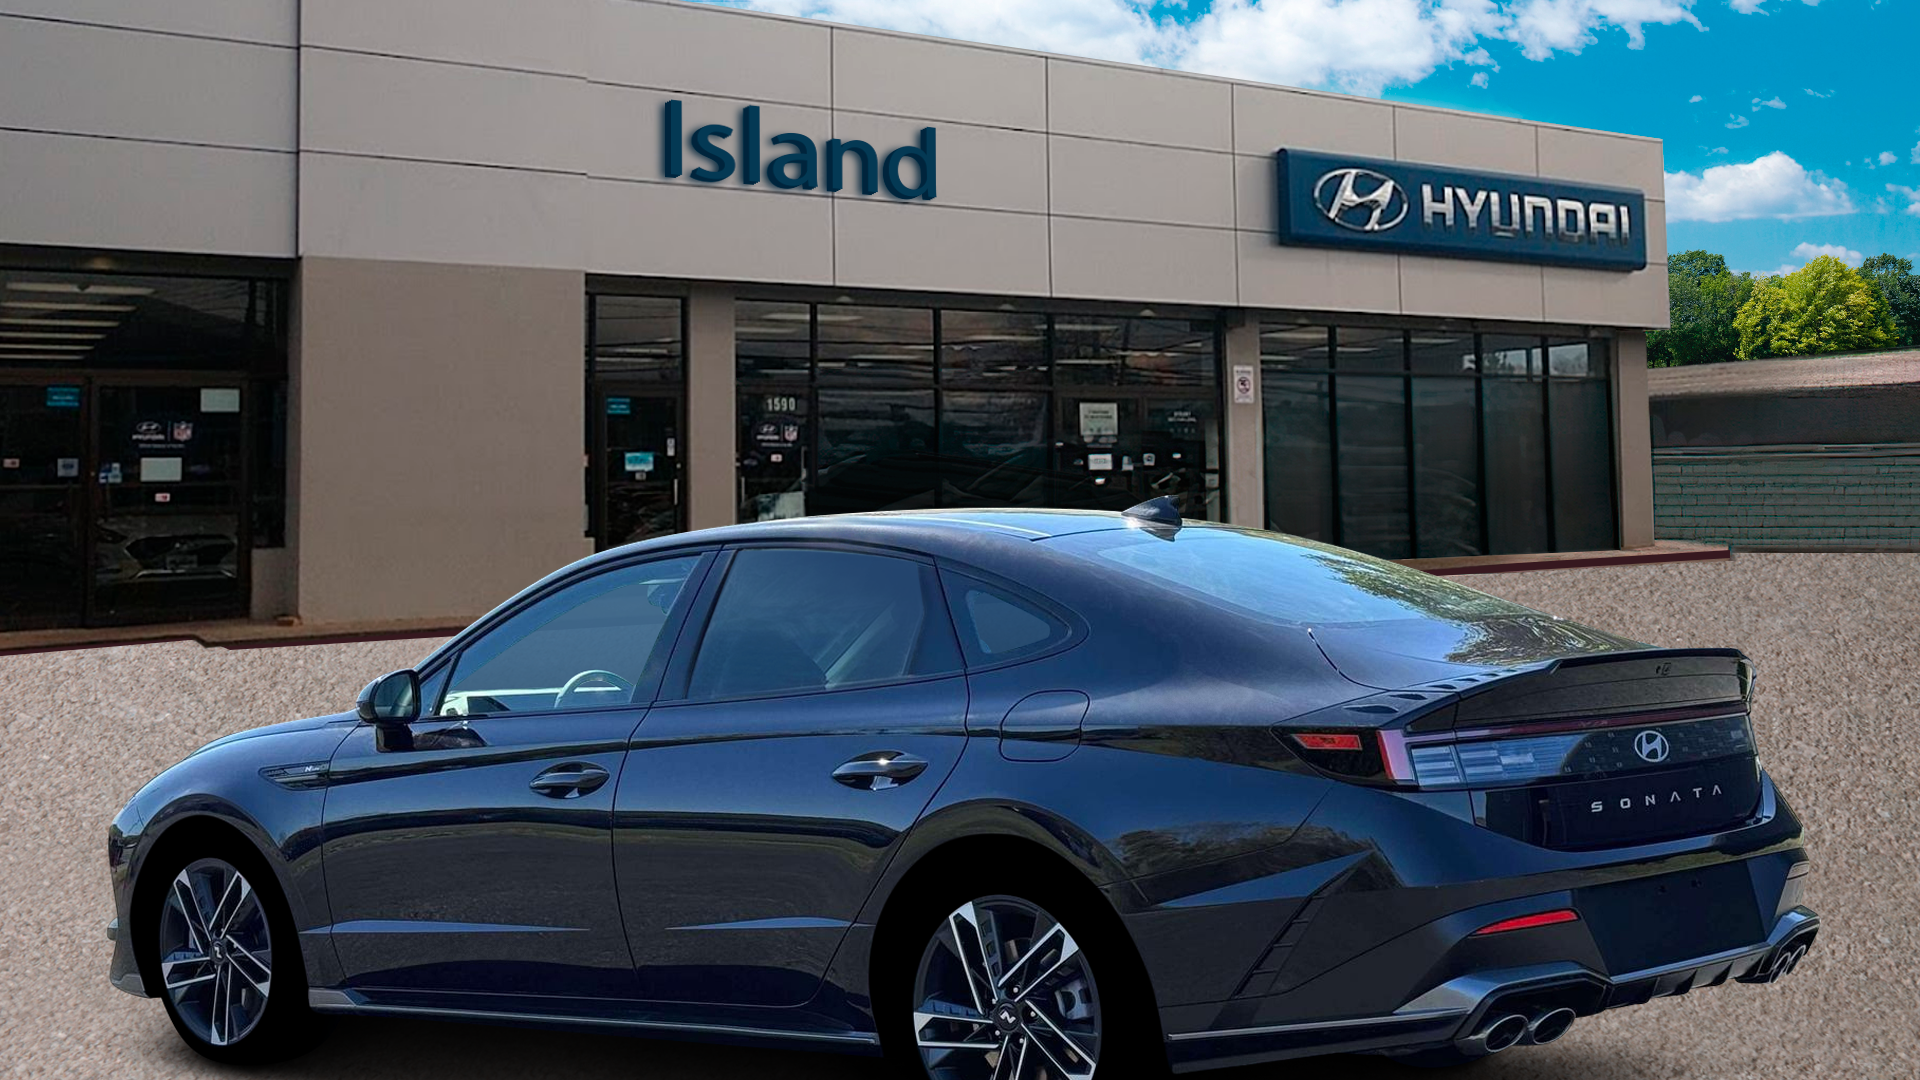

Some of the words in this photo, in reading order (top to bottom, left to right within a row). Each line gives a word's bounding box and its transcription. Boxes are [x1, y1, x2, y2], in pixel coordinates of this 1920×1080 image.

[664, 99, 937, 200] Island
[1422, 183, 1631, 247] HYUNDAI
[766, 397, 796, 411] 1590
[1591, 784, 1722, 812] SONATA
